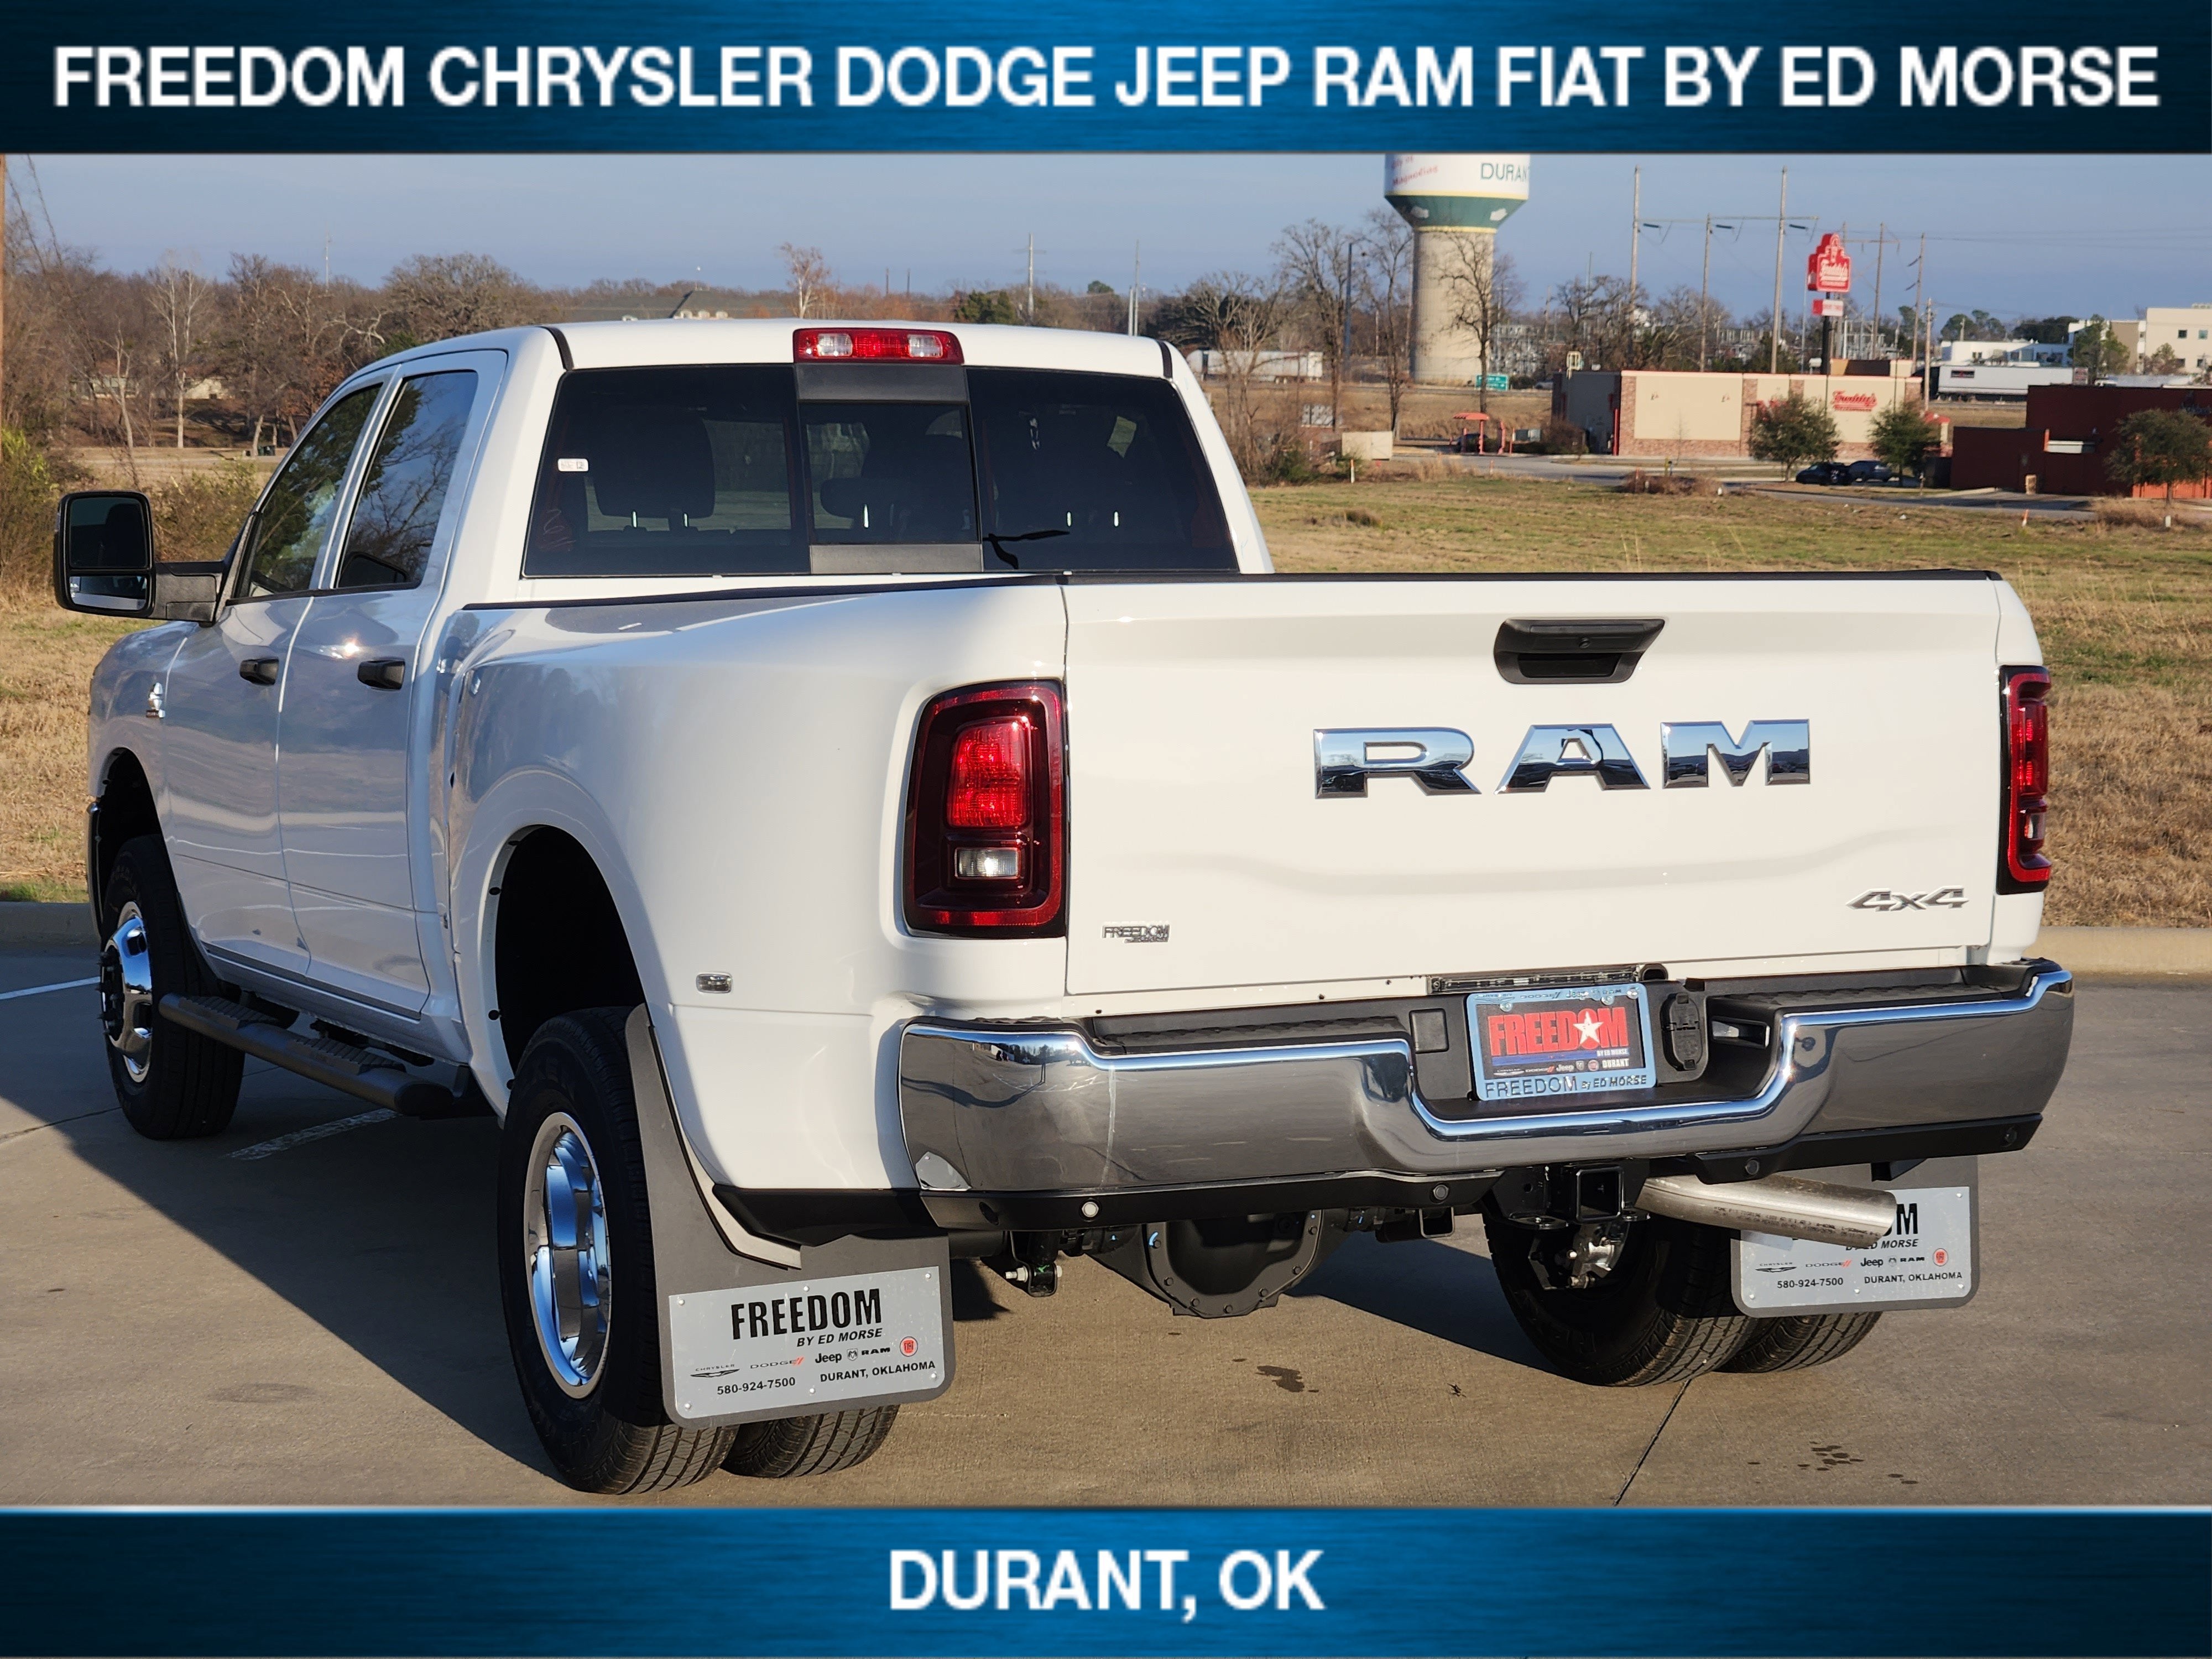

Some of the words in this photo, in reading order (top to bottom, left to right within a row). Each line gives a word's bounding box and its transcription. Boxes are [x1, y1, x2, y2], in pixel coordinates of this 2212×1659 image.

[1313, 719, 1811, 799] RAM
[1846, 885, 1969, 912] 4x4
[1102, 924, 1170, 938] FREEDOM
[1488, 1006, 1629, 1057] FREEDOM
[1556, 1064, 1574, 1072] Jeep
[1601, 1058, 1630, 1068] DURANT
[1485, 1076, 1578, 1098] FREEDOM
[1593, 1078, 1606, 1088] ED
[1609, 1075, 1647, 1087] MORSE
[1881, 1239, 1919, 1249] MORSE
[1860, 1258, 1884, 1267] Jeep
[1777, 1277, 1844, 1289] 580-924-7500
[1864, 1275, 1905, 1284] DURANT,
[1908, 1272, 1963, 1281] OKLAHOMA
[731, 1288, 882, 1340] FREEDOM
[797, 1335, 814, 1347] BY
[818, 1333, 834, 1344] ED
[838, 1328, 883, 1342] MORSE
[750, 1359, 797, 1369] DODGE
[815, 1353, 842, 1364] Jeep
[861, 1347, 891, 1355] RAM
[717, 1377, 796, 1395] 580-924-7500
[820, 1369, 868, 1383] DURANT,
[872, 1360, 936, 1376] OKLAHOMA
